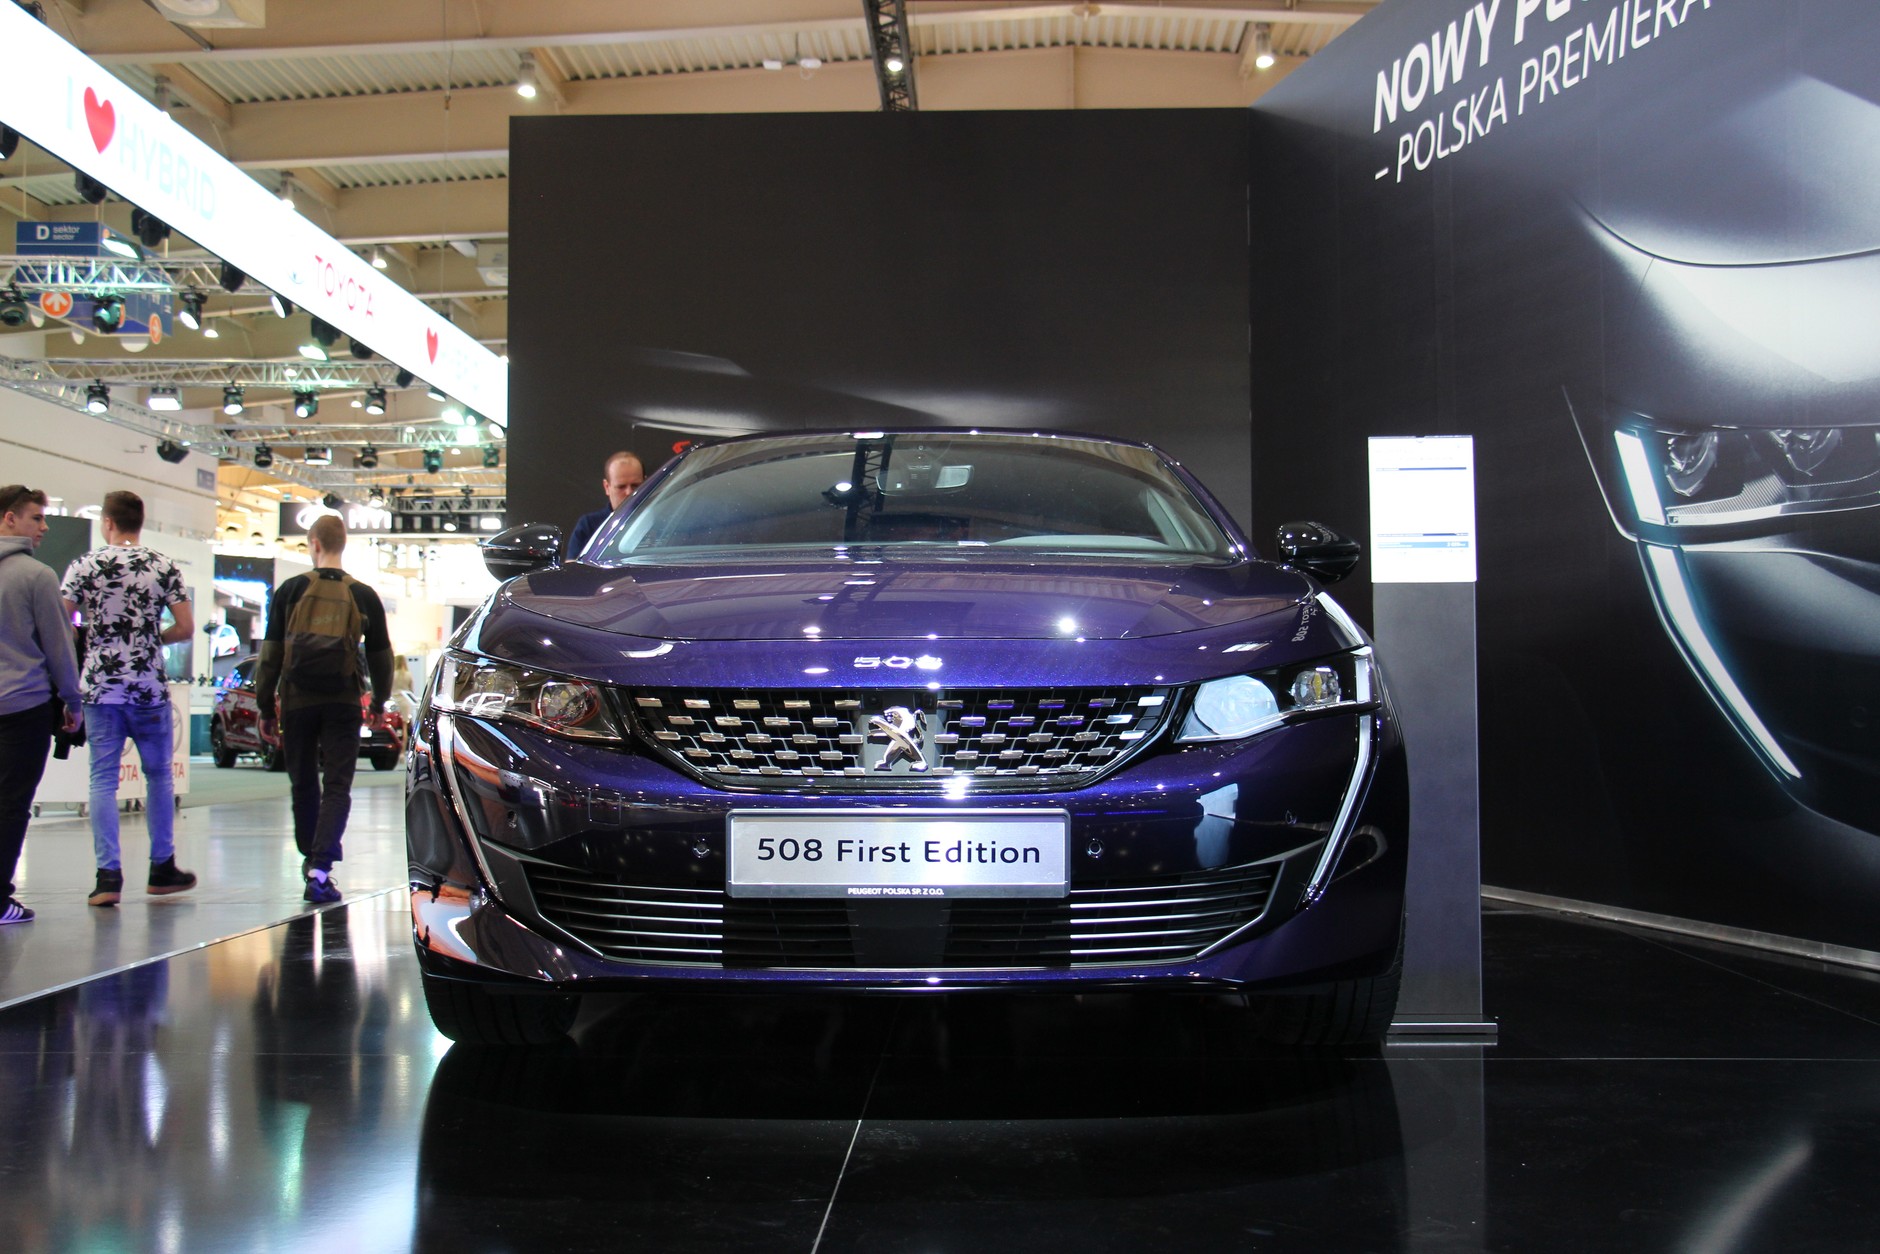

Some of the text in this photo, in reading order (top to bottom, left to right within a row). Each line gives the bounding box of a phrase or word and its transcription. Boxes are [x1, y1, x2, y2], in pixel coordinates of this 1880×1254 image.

[1374, 0, 1499, 134] NOWY
[1397, 77, 1507, 183] POLSKA
[119, 113, 215, 221] HYBRID
[36, 225, 80, 240] D sektor
[314, 254, 373, 321] TOYOTA
[757, 838, 1040, 863] 508 First Edition
[847, 887, 882, 895] PEUGEOT
[882, 887, 911, 895] POLSKA
[911, 887, 922, 895] SP.
